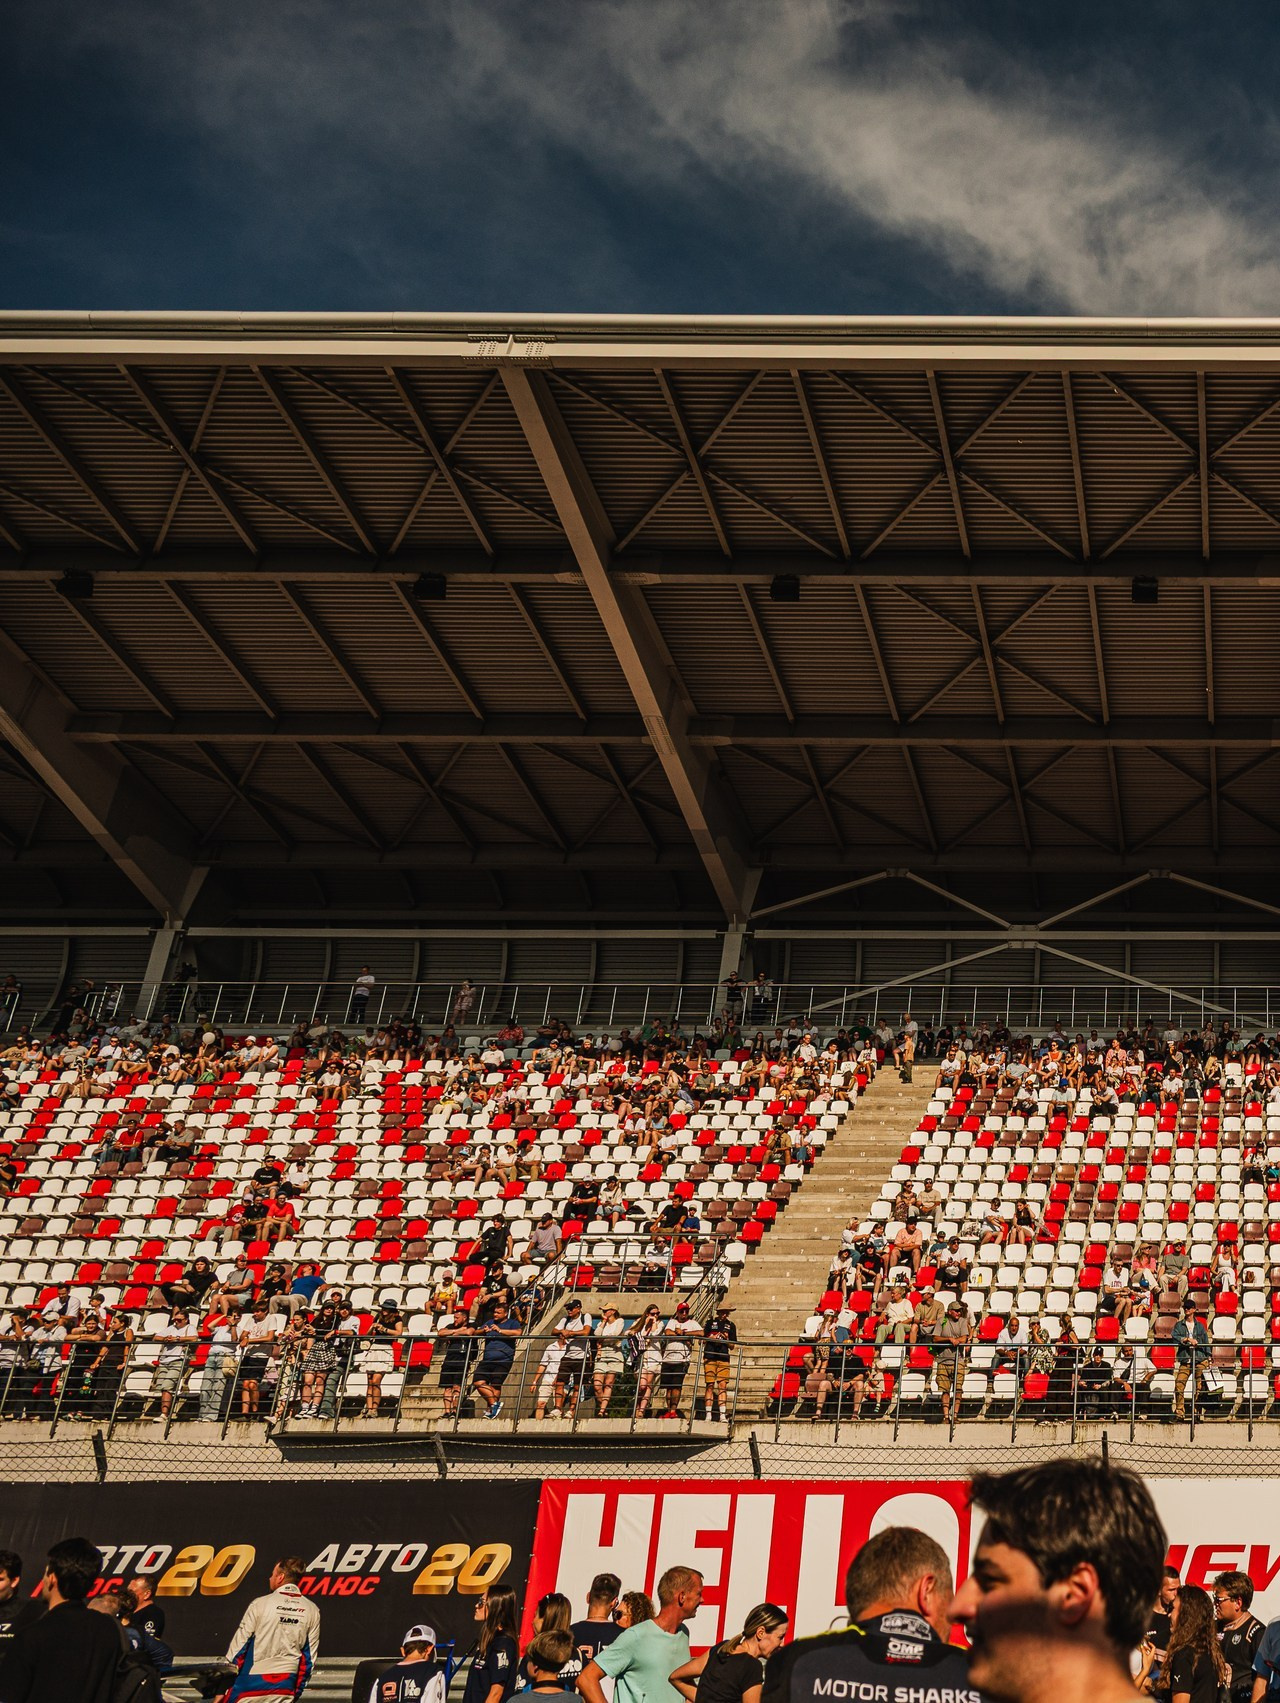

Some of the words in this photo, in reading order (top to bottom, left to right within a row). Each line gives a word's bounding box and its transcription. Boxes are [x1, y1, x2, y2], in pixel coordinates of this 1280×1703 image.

[155, 1544, 256, 1596] 20
[306, 1543, 429, 1573] АВТО
[412, 1543, 512, 1595] 20
[813, 1677, 889, 1701] MOTOR
[894, 1686, 982, 1703] SHARKS
